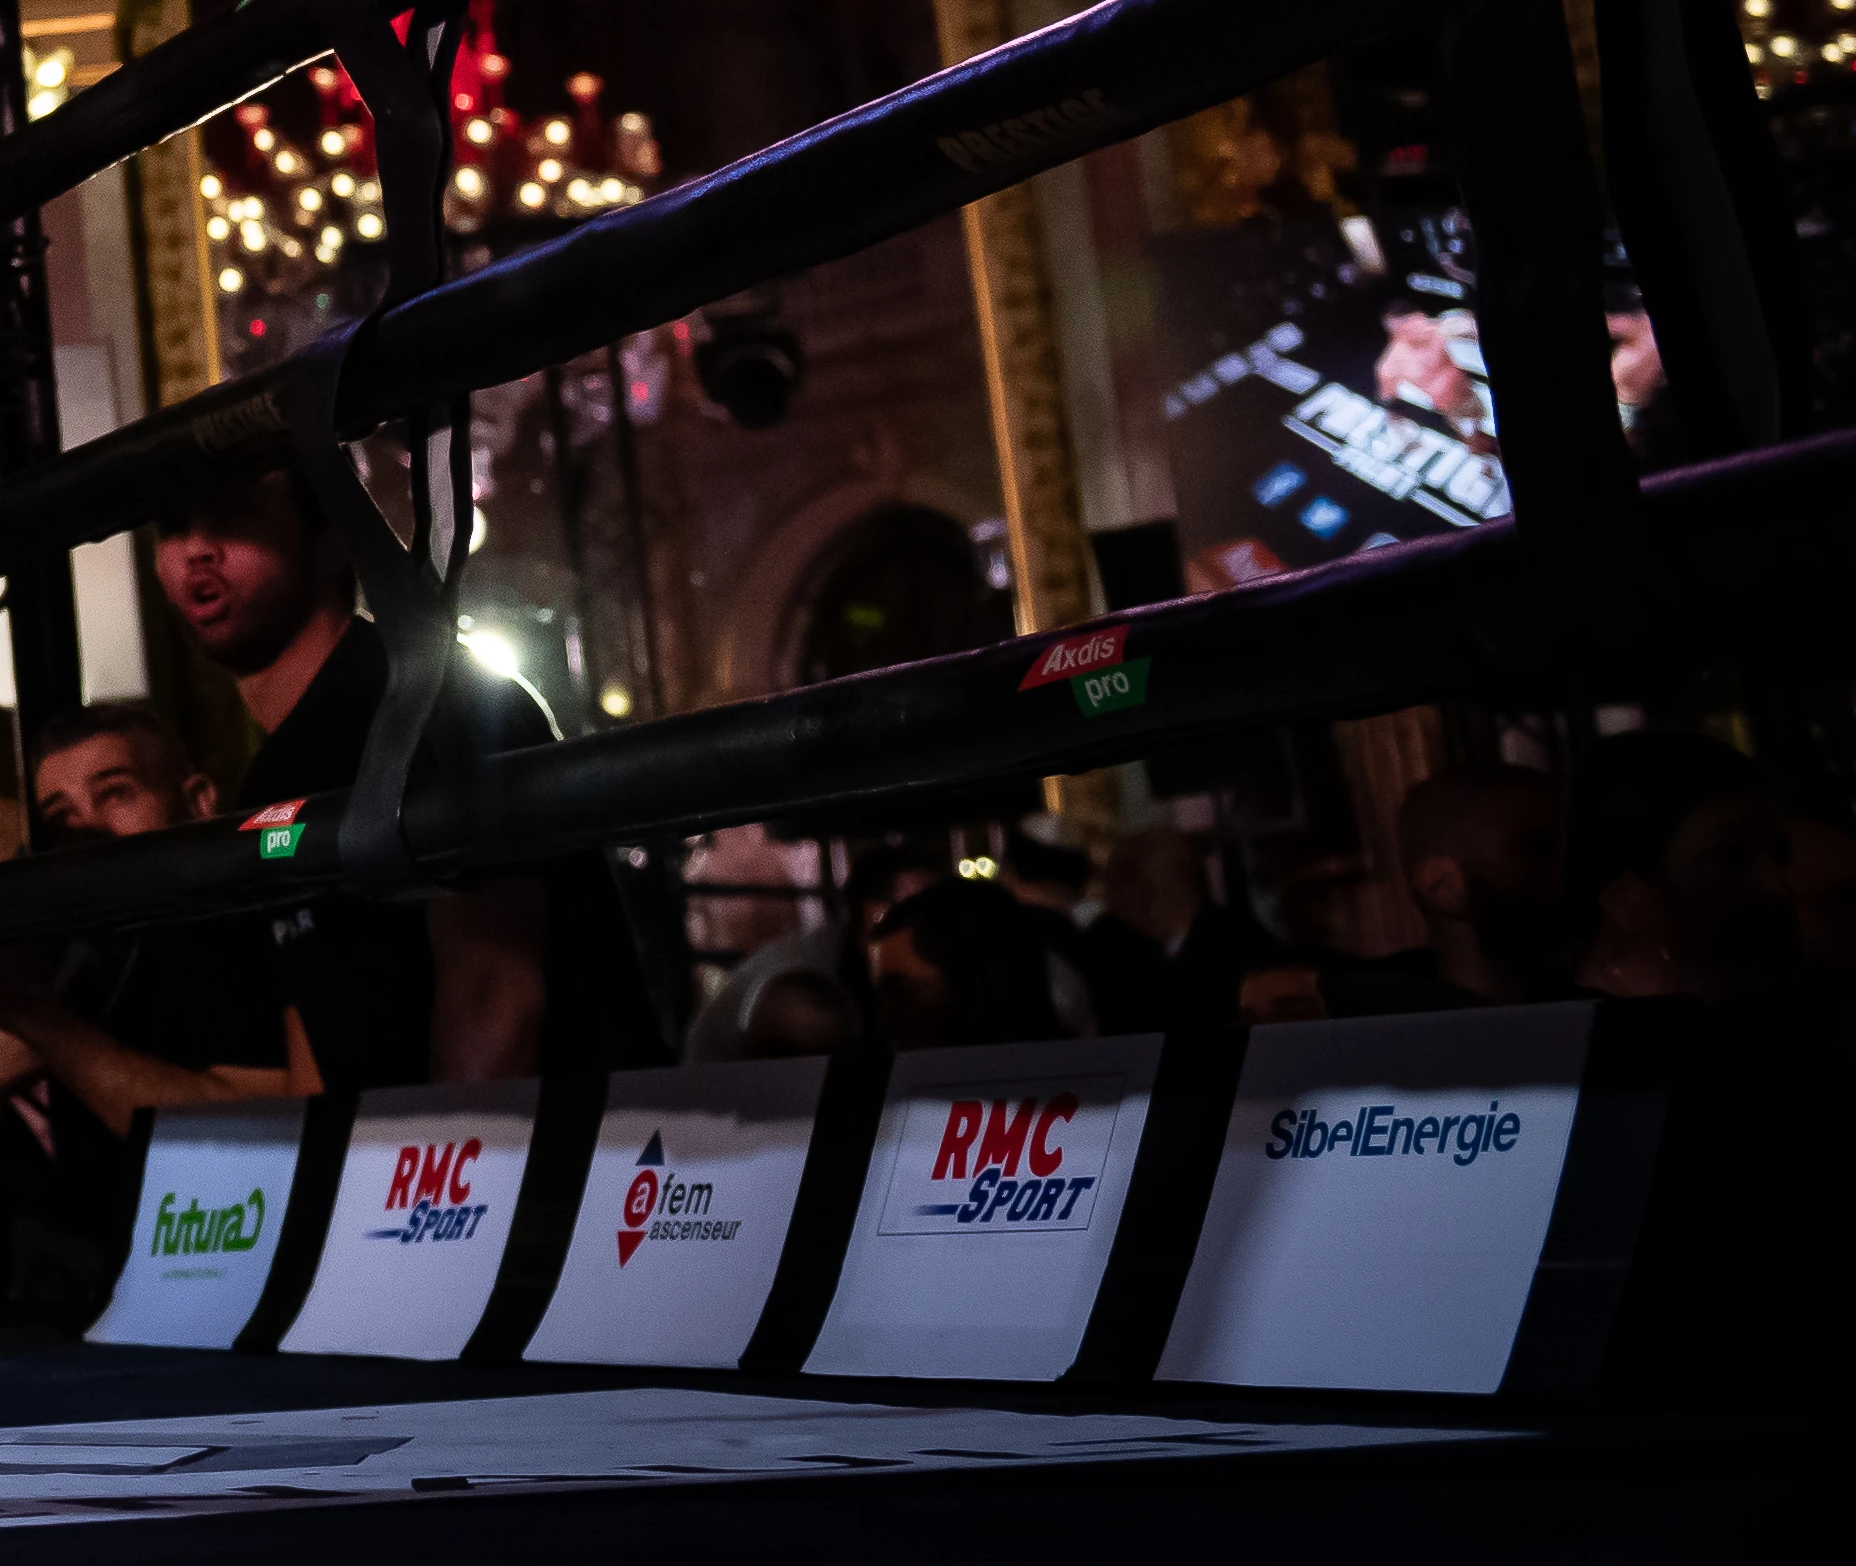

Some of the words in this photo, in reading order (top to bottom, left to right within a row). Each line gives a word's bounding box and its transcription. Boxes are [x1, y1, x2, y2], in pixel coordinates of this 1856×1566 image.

[1040, 635, 1117, 677] Axdis
[1084, 671, 1131, 709] pro
[266, 830, 292, 854] pro
[930, 1092, 1080, 1181] RMC
[1264, 1100, 1521, 1167] SibelEnergie
[384, 1137, 482, 1212] RMC
[955, 1168, 1095, 1224] SPORT
[399, 1202, 488, 1243] SPORT
[648, 1218, 742, 1241] ascenseur
